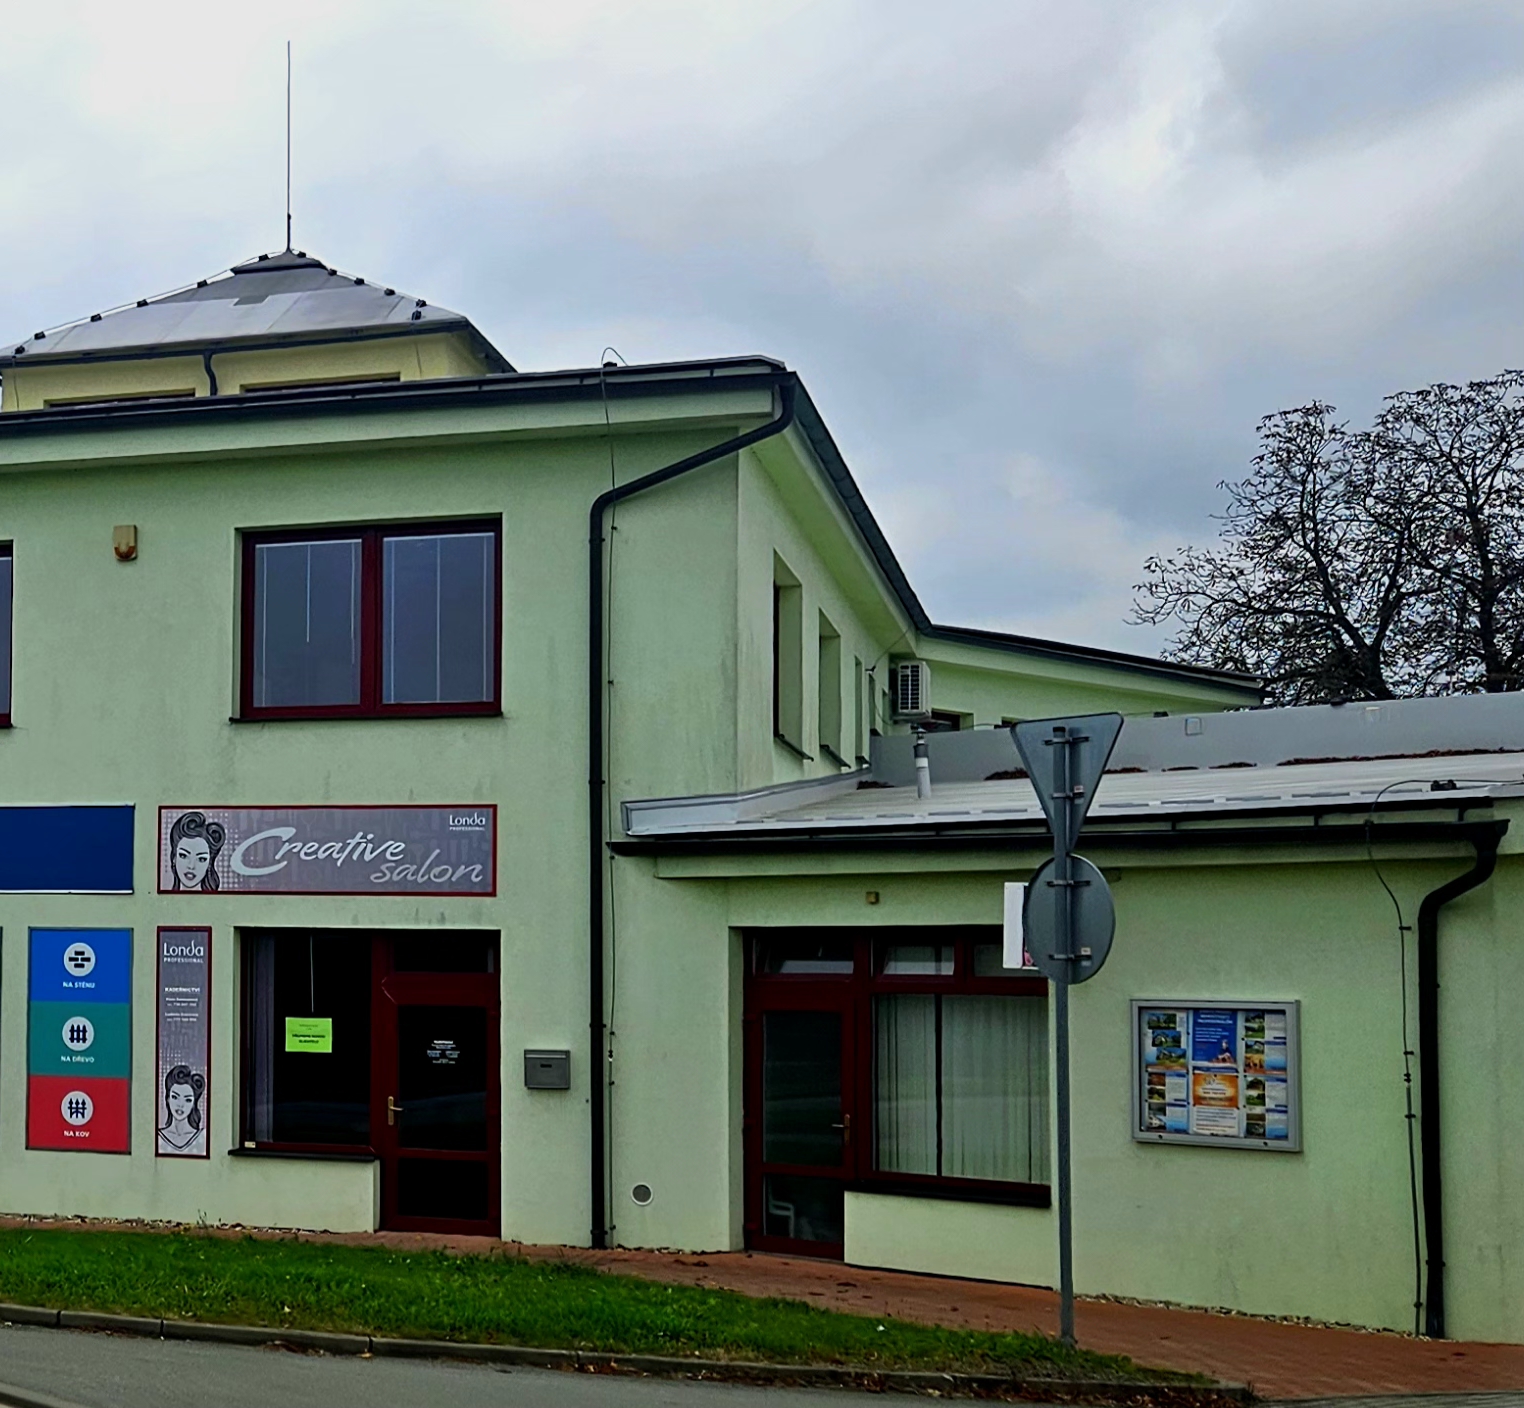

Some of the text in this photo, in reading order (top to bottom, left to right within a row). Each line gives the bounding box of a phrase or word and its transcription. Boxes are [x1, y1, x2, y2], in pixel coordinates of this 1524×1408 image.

[449, 812, 486, 826] Londa
[229, 827, 406, 876] Creative
[370, 849, 484, 883] salon
[163, 940, 204, 956] Londa
[75, 1130, 90, 1138] KOV
